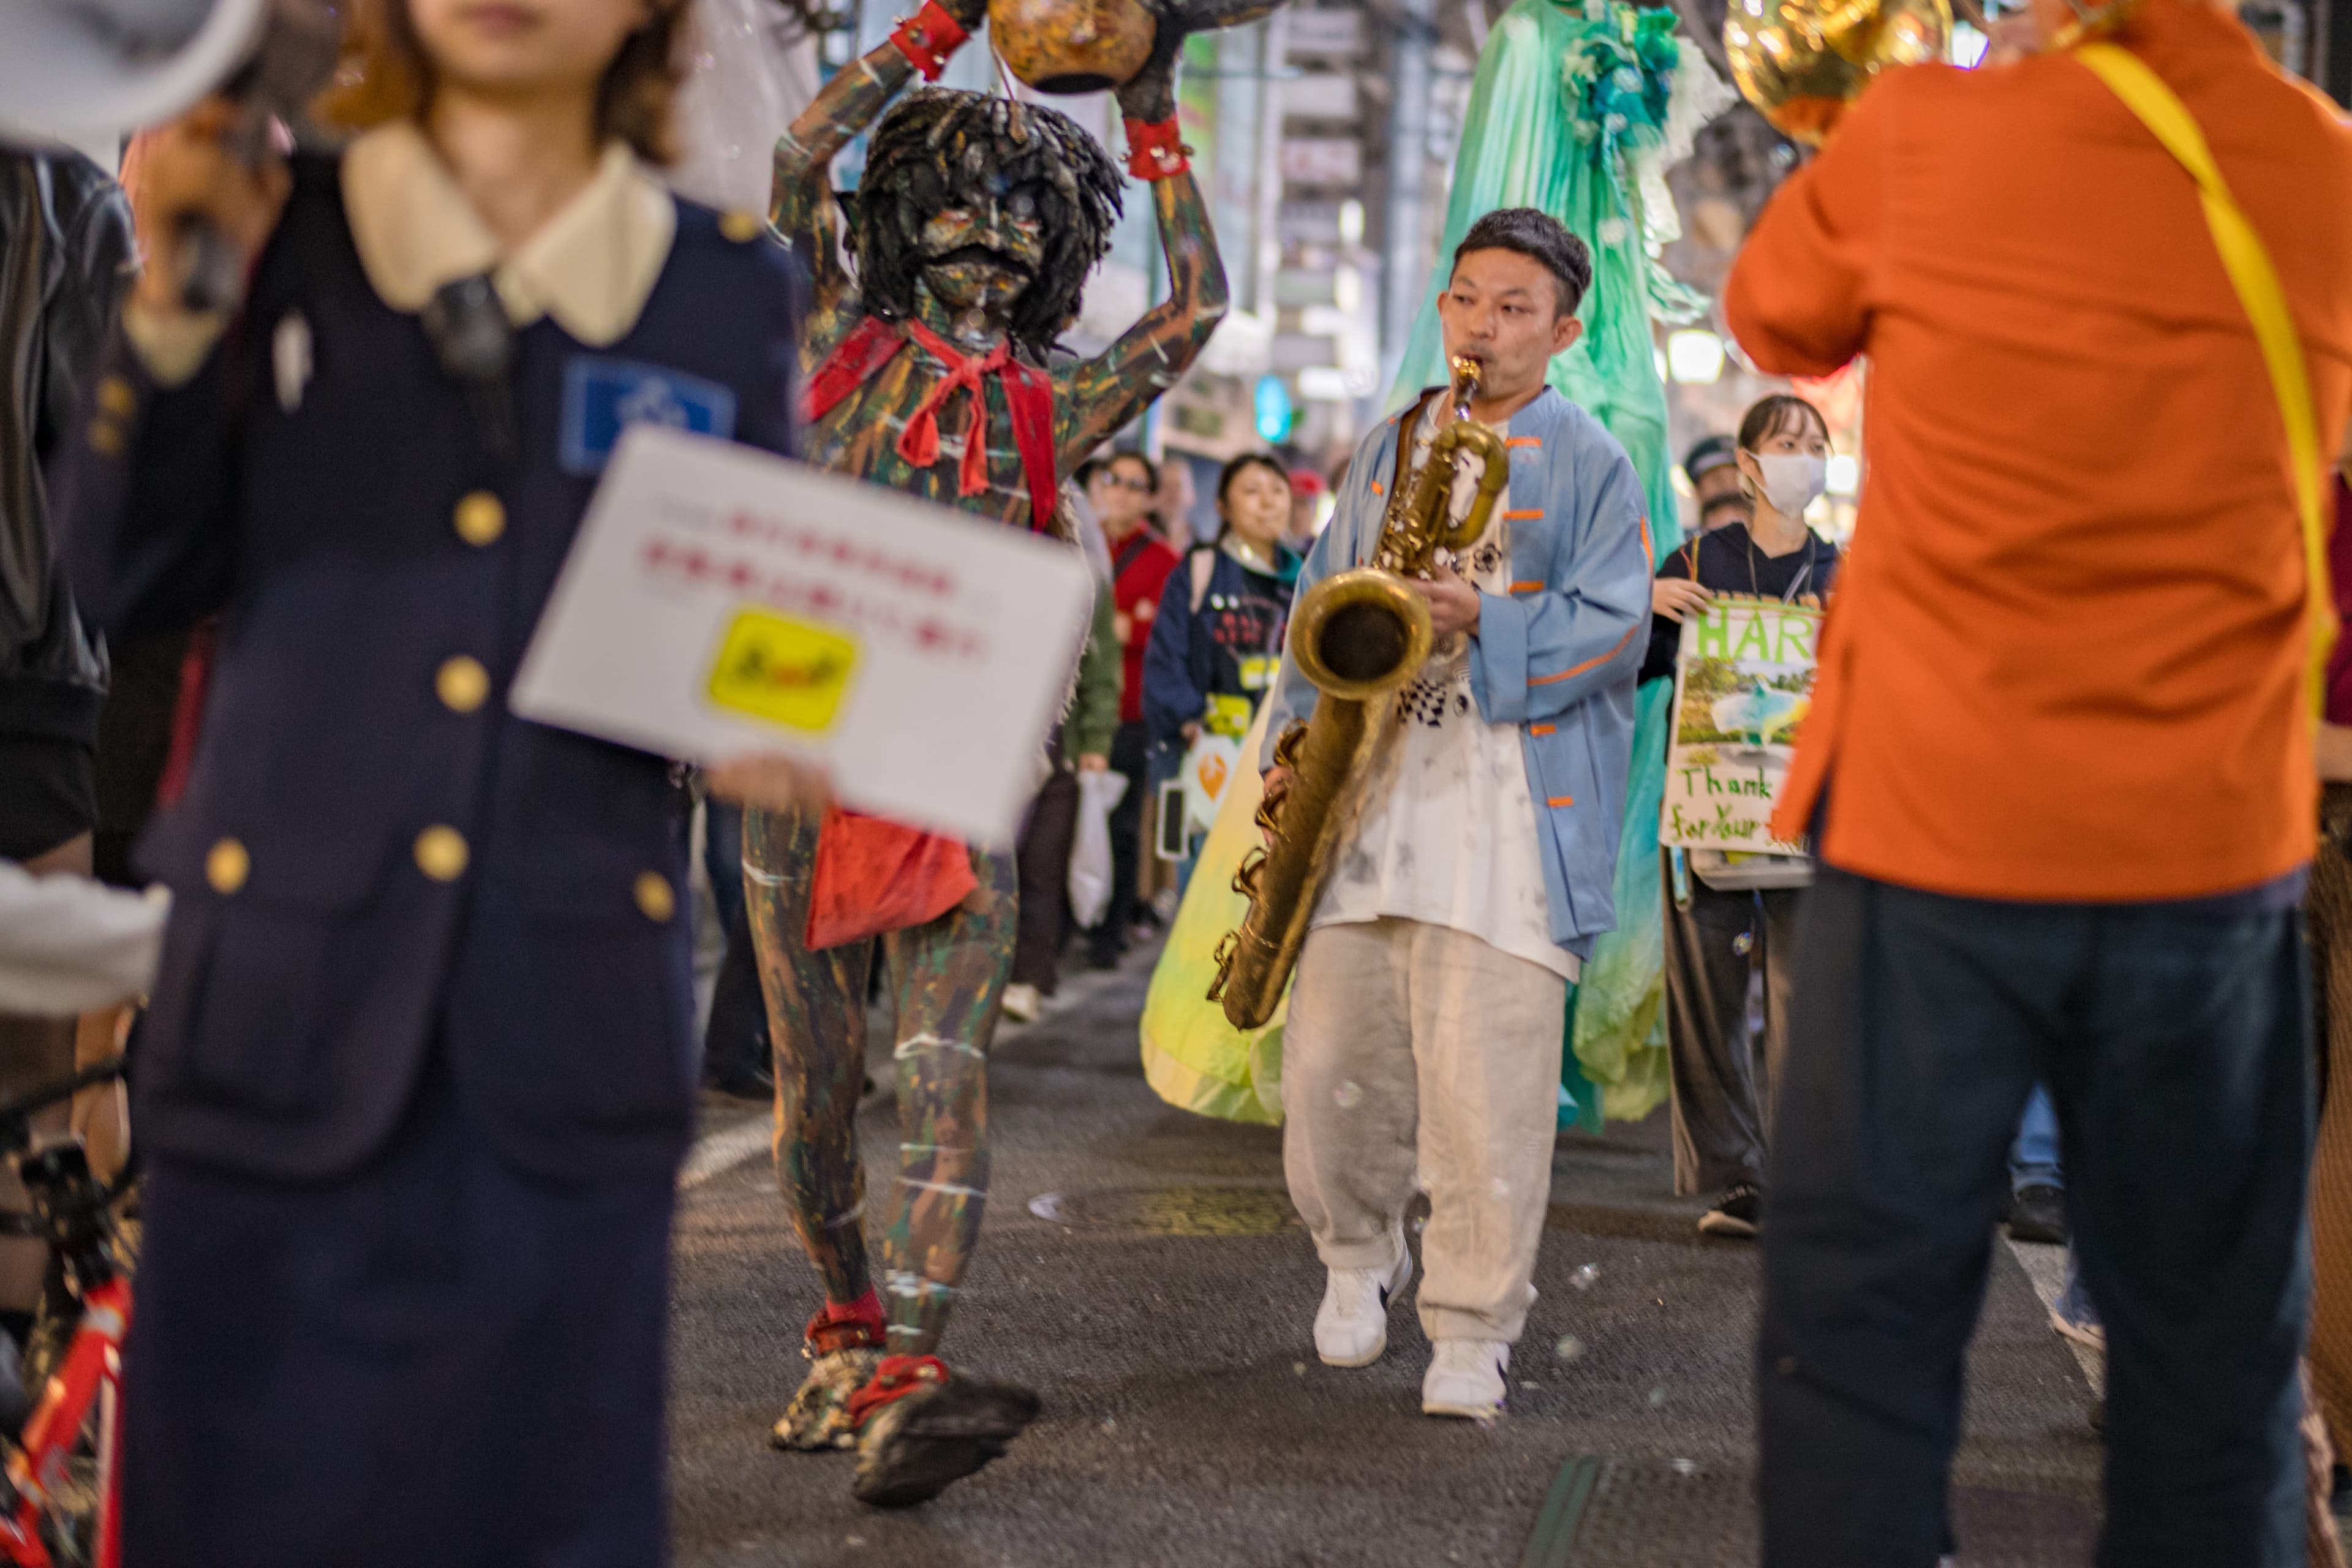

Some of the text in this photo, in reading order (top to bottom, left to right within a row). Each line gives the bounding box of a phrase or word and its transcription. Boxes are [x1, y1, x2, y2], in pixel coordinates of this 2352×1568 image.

[1697, 603, 1814, 665] HAR
[1676, 766, 1773, 799] Thank
[1670, 803, 1709, 842] for
